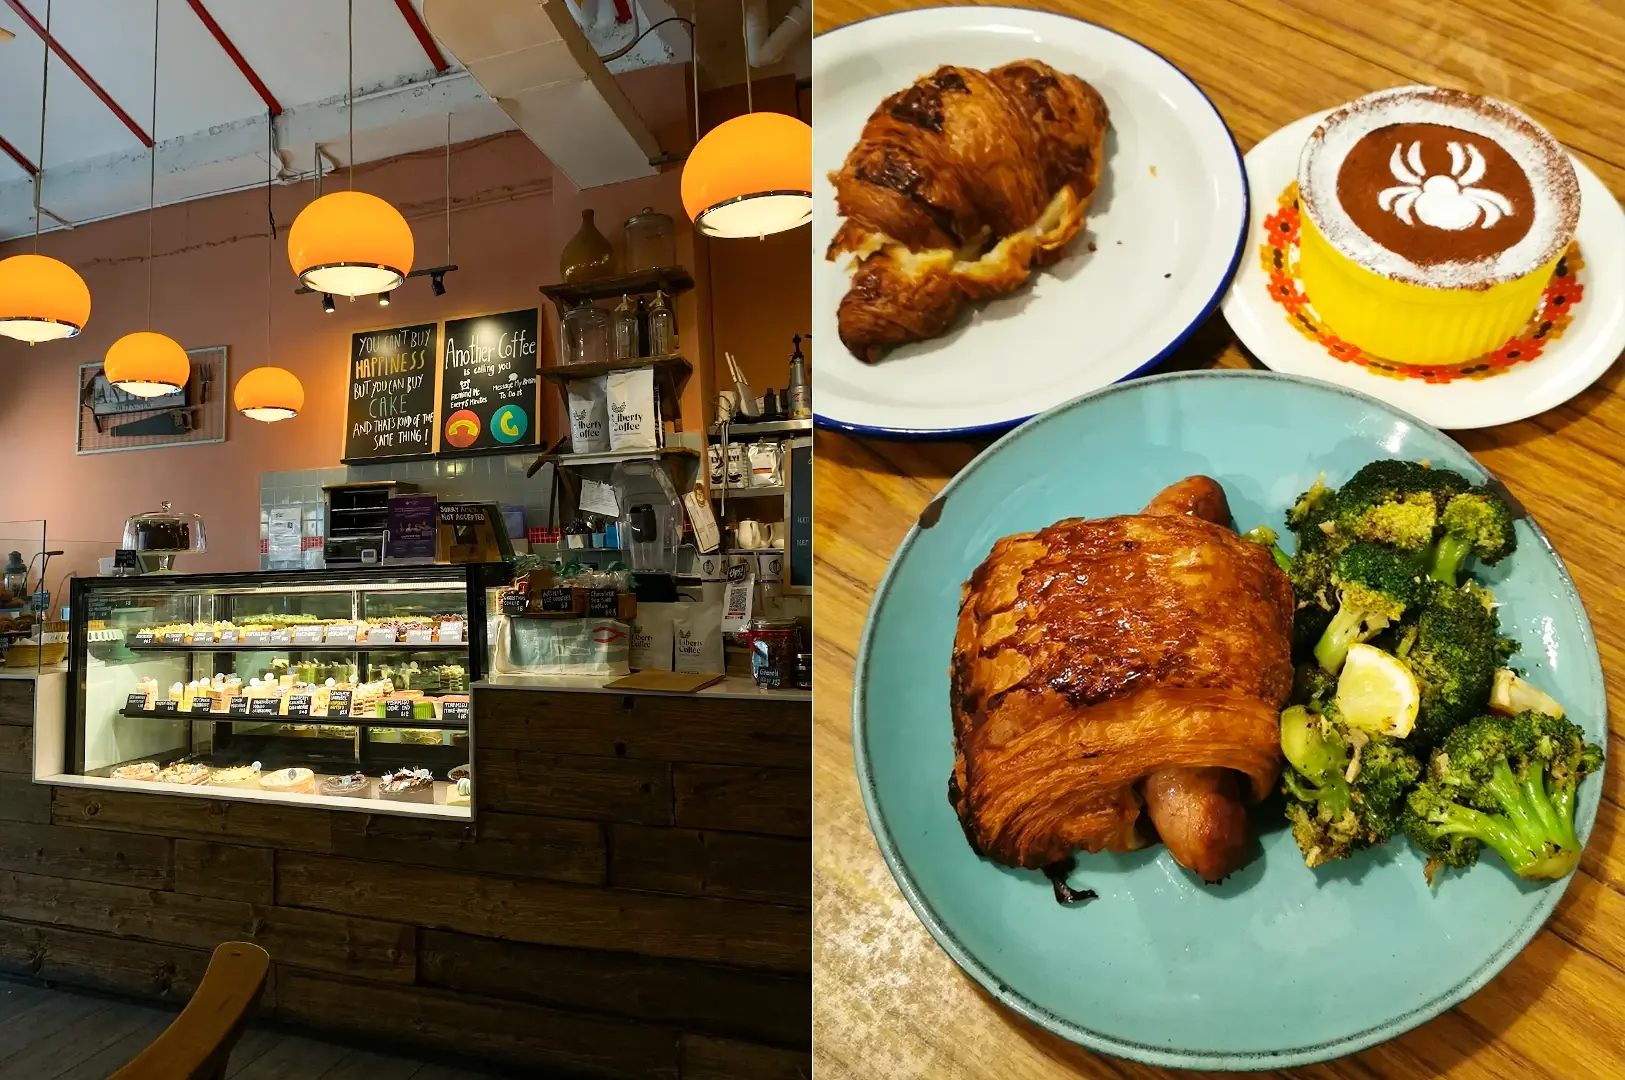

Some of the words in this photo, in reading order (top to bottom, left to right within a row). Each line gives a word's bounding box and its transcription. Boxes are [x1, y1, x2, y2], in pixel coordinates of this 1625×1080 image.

[359, 336, 380, 356] YOU
[385, 330, 410, 350] CAN'T
[411, 329, 431, 347] BUY
[445, 335, 495, 369] Another
[499, 330, 536, 358] Coffee
[356, 350, 426, 379] HAPPINESS
[473, 363, 494, 376] calling
[354, 380, 371, 400] BUT
[371, 380, 387, 398] YOU
[388, 378, 404, 394] CAN
[407, 374, 424, 393] BUY
[369, 394, 408, 418] CAKE
[353, 421, 372, 438] AND
[373, 433, 393, 450] SAME
[441, 513, 454, 521] NOT
[455, 513, 485, 521] ACCEPTED
